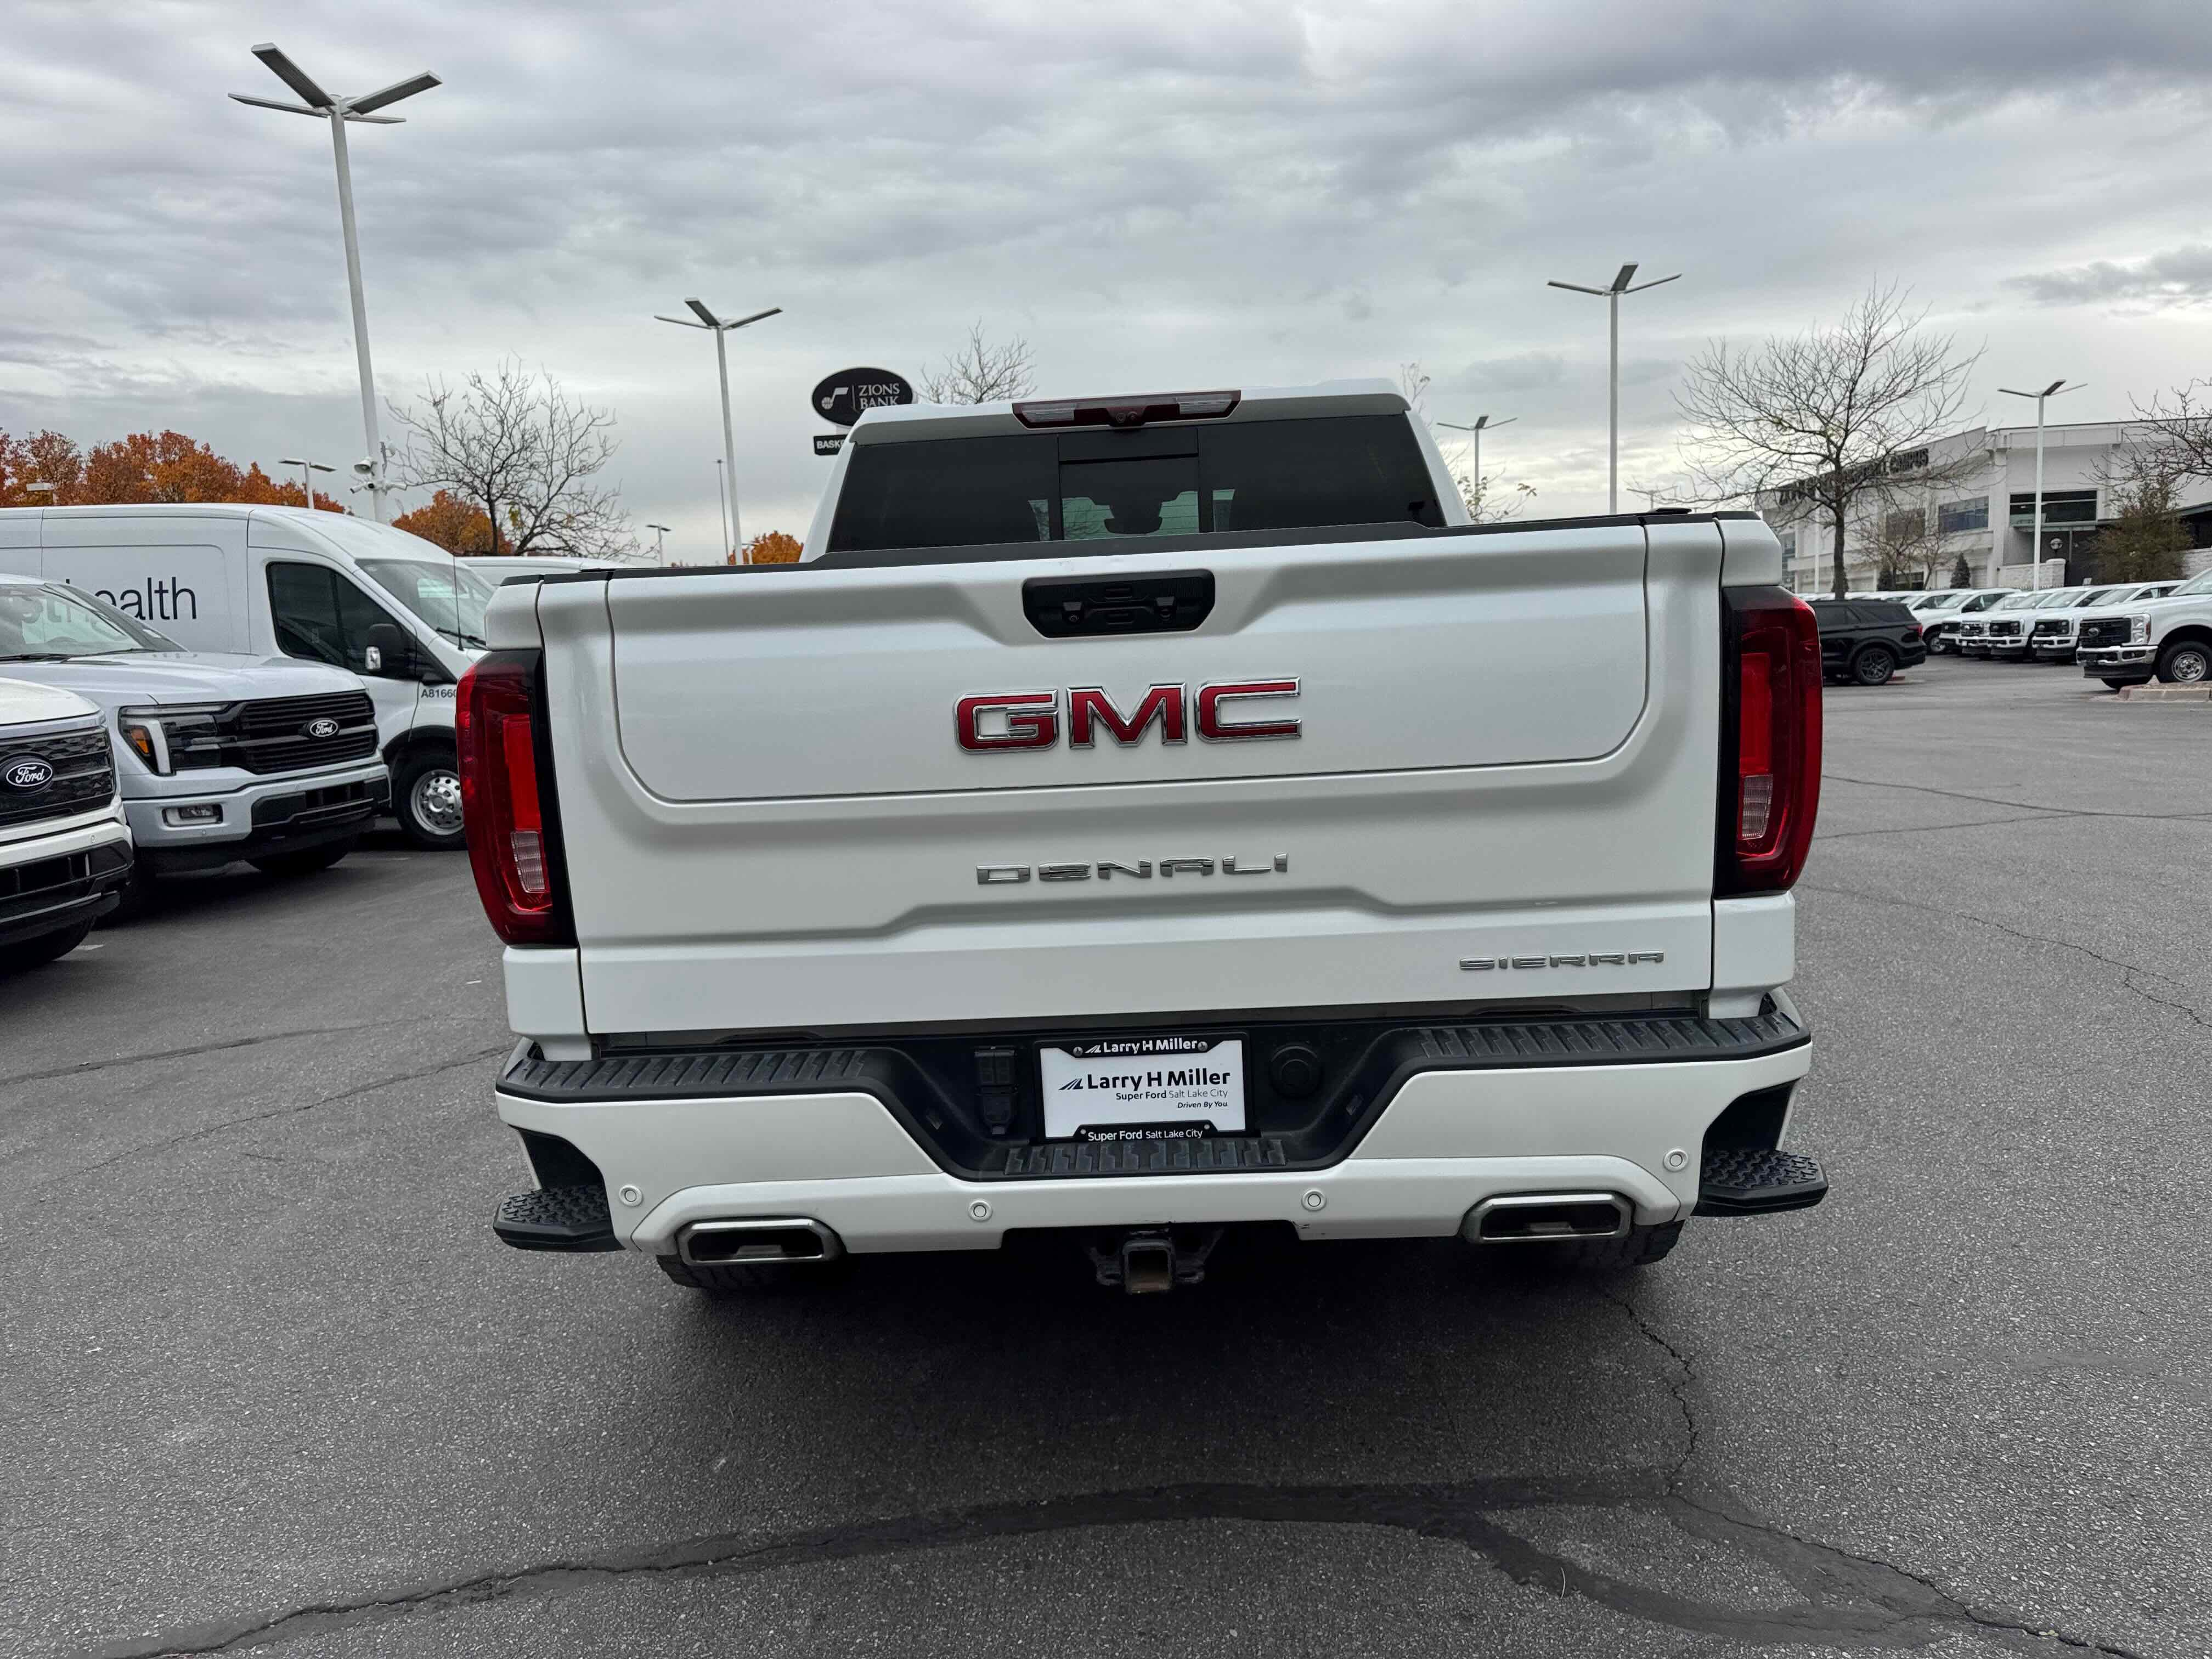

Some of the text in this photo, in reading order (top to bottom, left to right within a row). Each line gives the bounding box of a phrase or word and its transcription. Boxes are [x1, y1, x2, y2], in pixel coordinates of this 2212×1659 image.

[858, 383, 900, 396] ZIONS
[860, 396, 899, 409] BANK
[953, 676, 1301, 754] GMC
[15, 766, 45, 783] Ford
[976, 852, 1288, 885] DENALI
[1459, 950, 1664, 970] SIERRA
[1103, 1037, 1198, 1054] Larry H Miller
[1087, 1068, 1230, 1091] Larry H Miller
[1116, 1088, 1229, 1102] Super Ford Salt Lake City
[1088, 1128, 1203, 1142] Super Ford Salt Lake City
